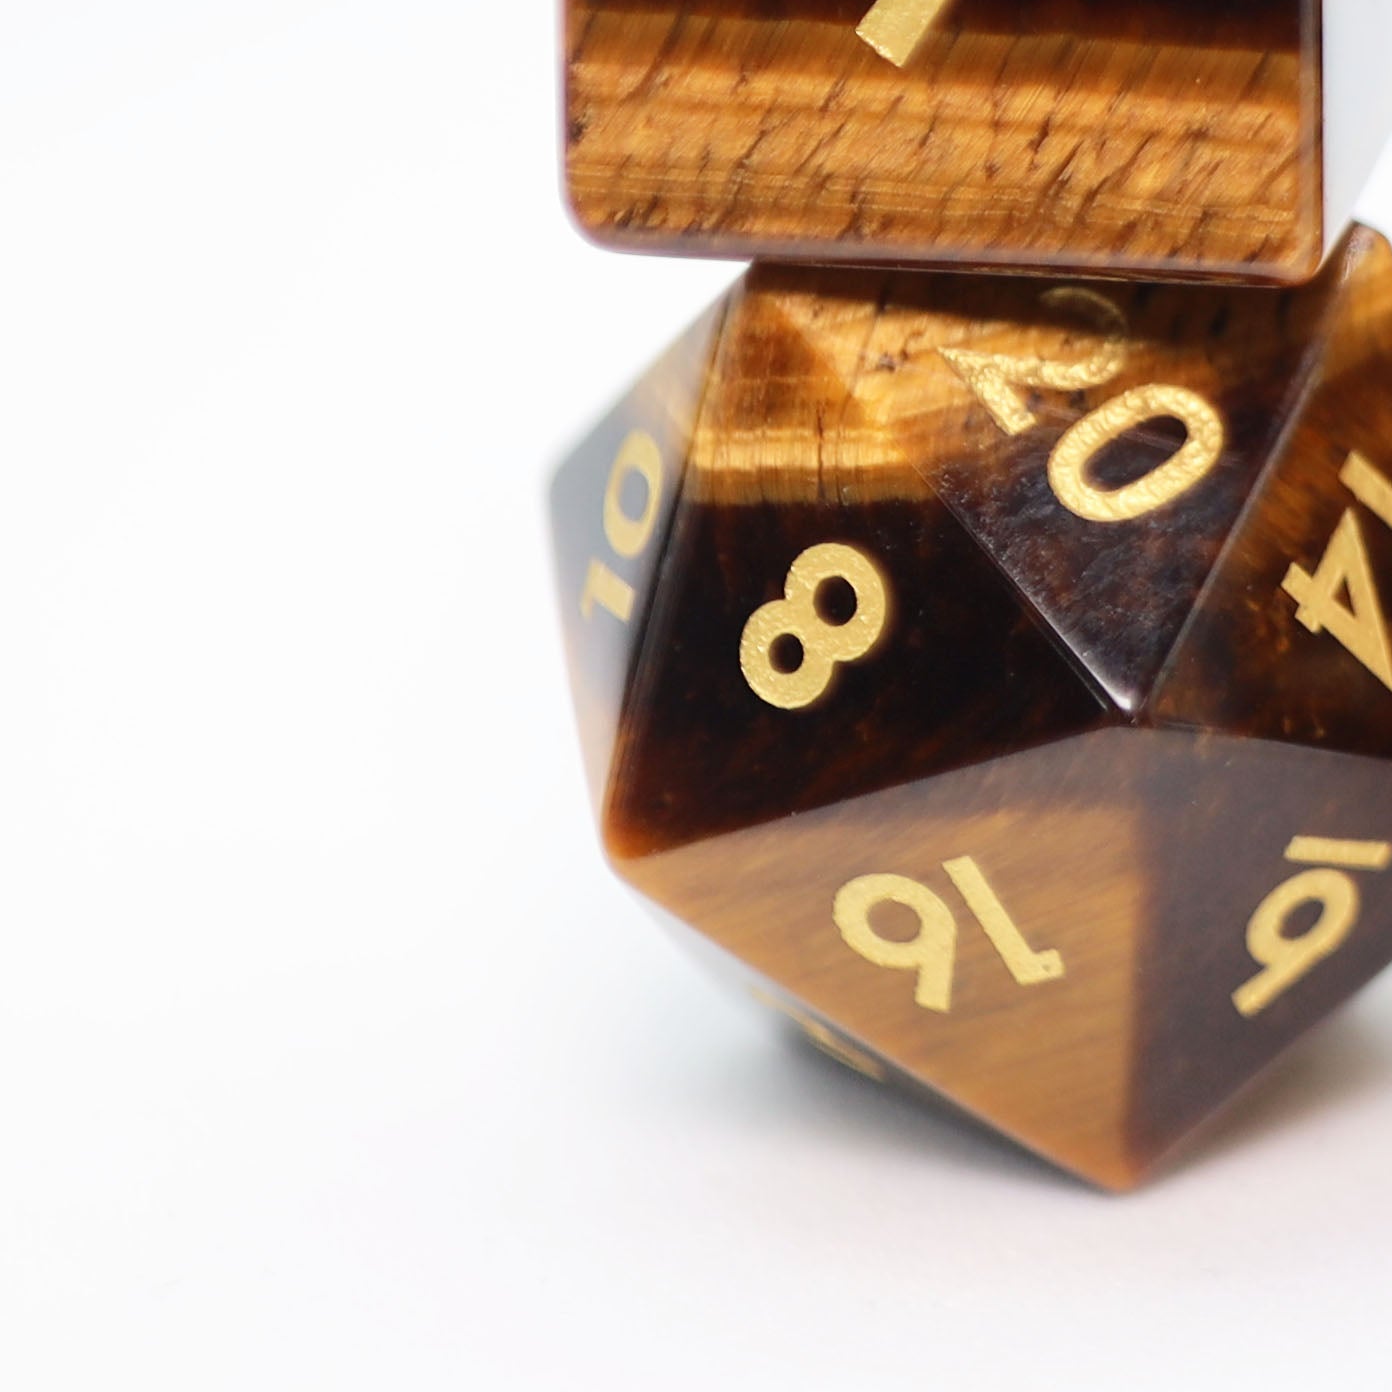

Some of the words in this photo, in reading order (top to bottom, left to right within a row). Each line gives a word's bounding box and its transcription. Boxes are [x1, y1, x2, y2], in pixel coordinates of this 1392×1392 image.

[936, 286, 1225, 524] 20
[581, 428, 664, 623] 10
[738, 542, 888, 711] 8
